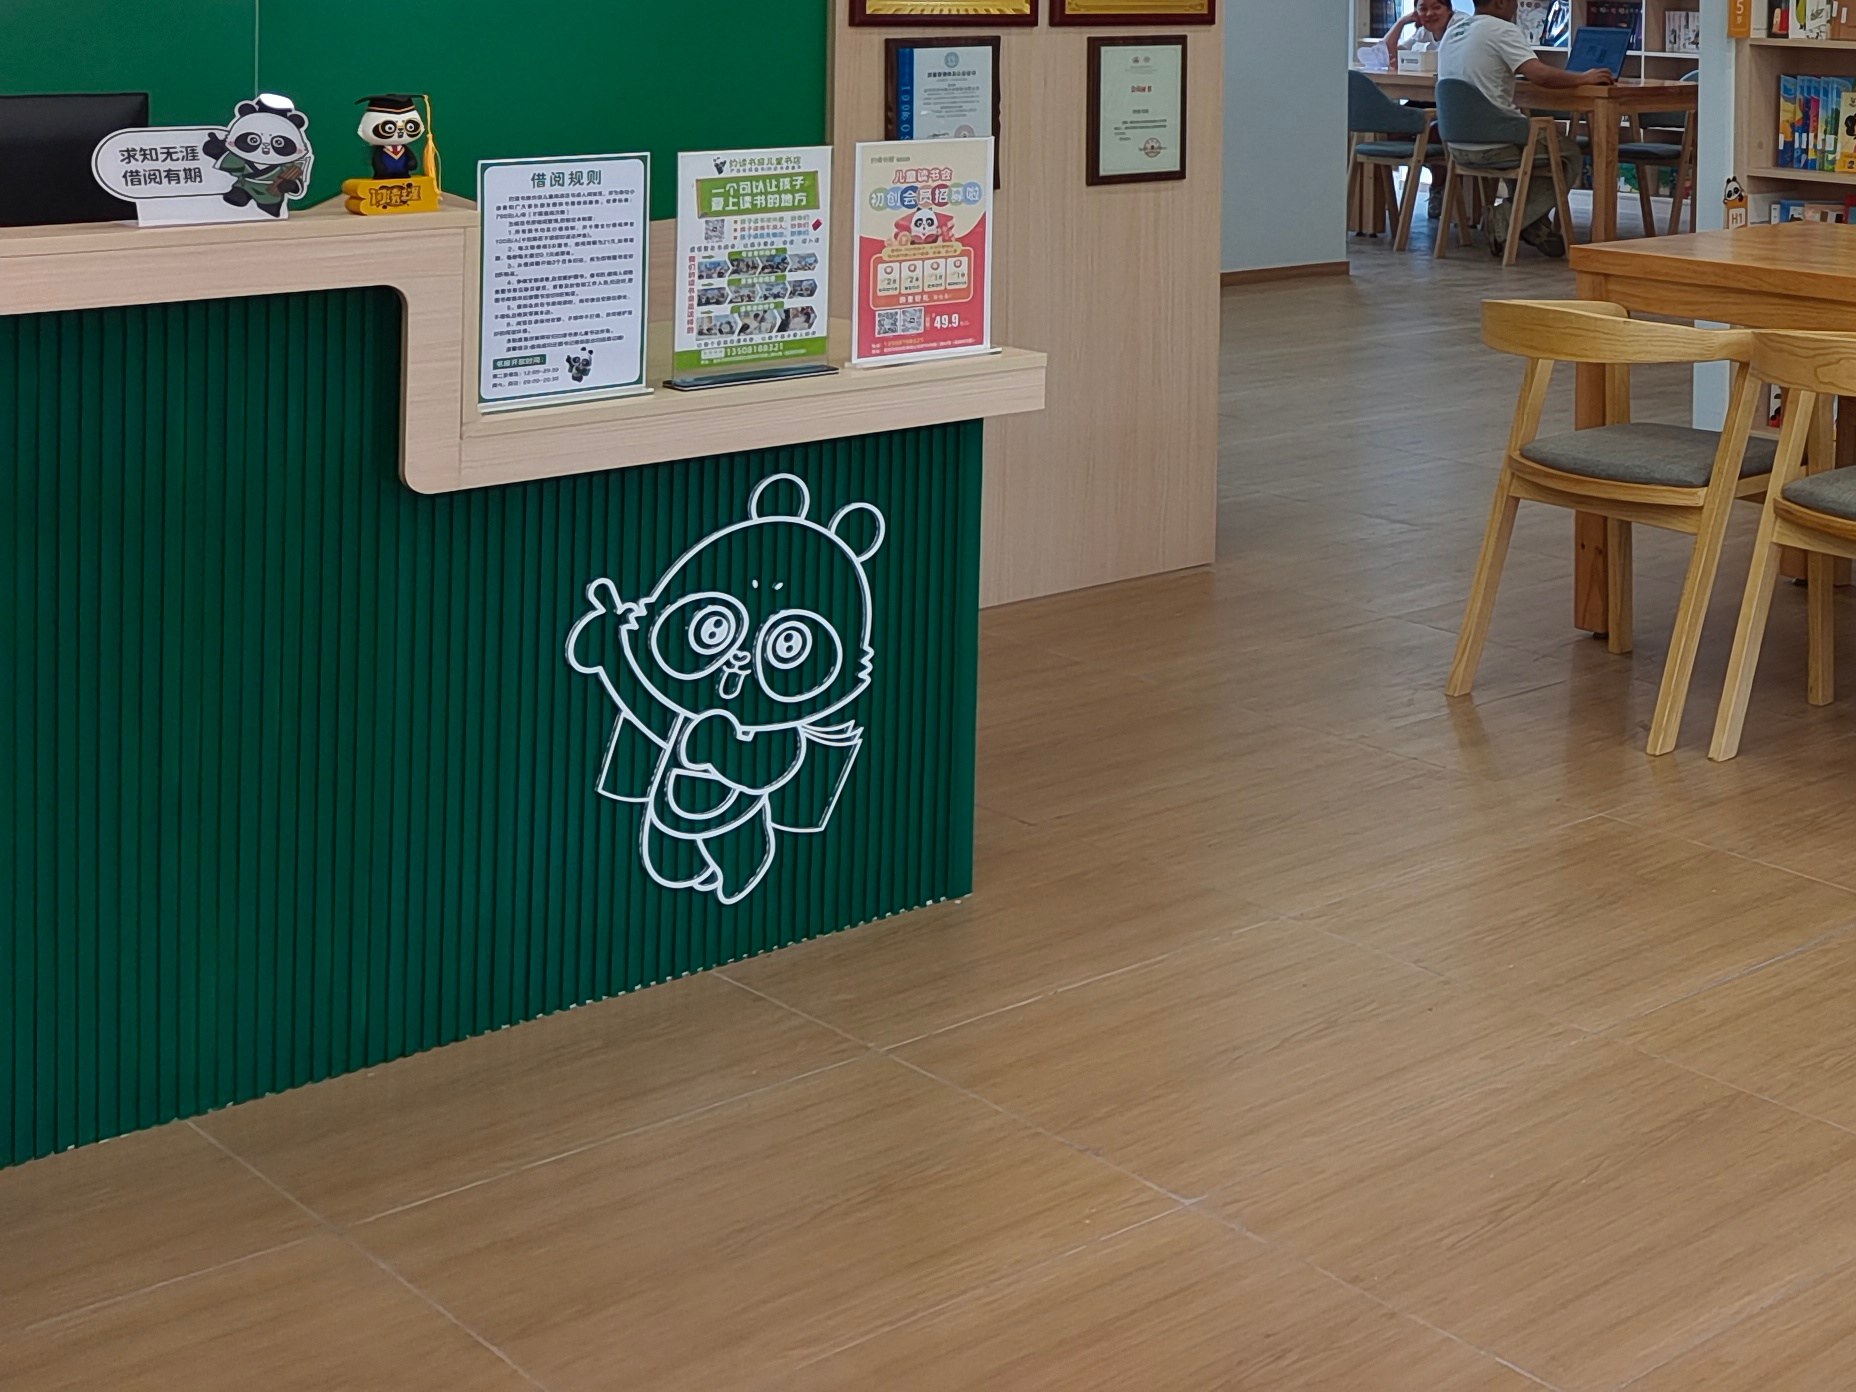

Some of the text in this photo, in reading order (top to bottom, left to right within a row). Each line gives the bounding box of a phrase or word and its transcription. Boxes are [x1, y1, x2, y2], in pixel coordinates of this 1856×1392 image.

[118, 144, 200, 163] 求知无涯
[121, 166, 203, 187] 借阅有期
[530, 169, 602, 189] 借阅规则
[711, 176, 804, 195] 一个可以让孩子
[711, 193, 807, 211] 爱上读书的地方
[1731, 213, 1743, 225] H1
[933, 313, 960, 329] 49.9
